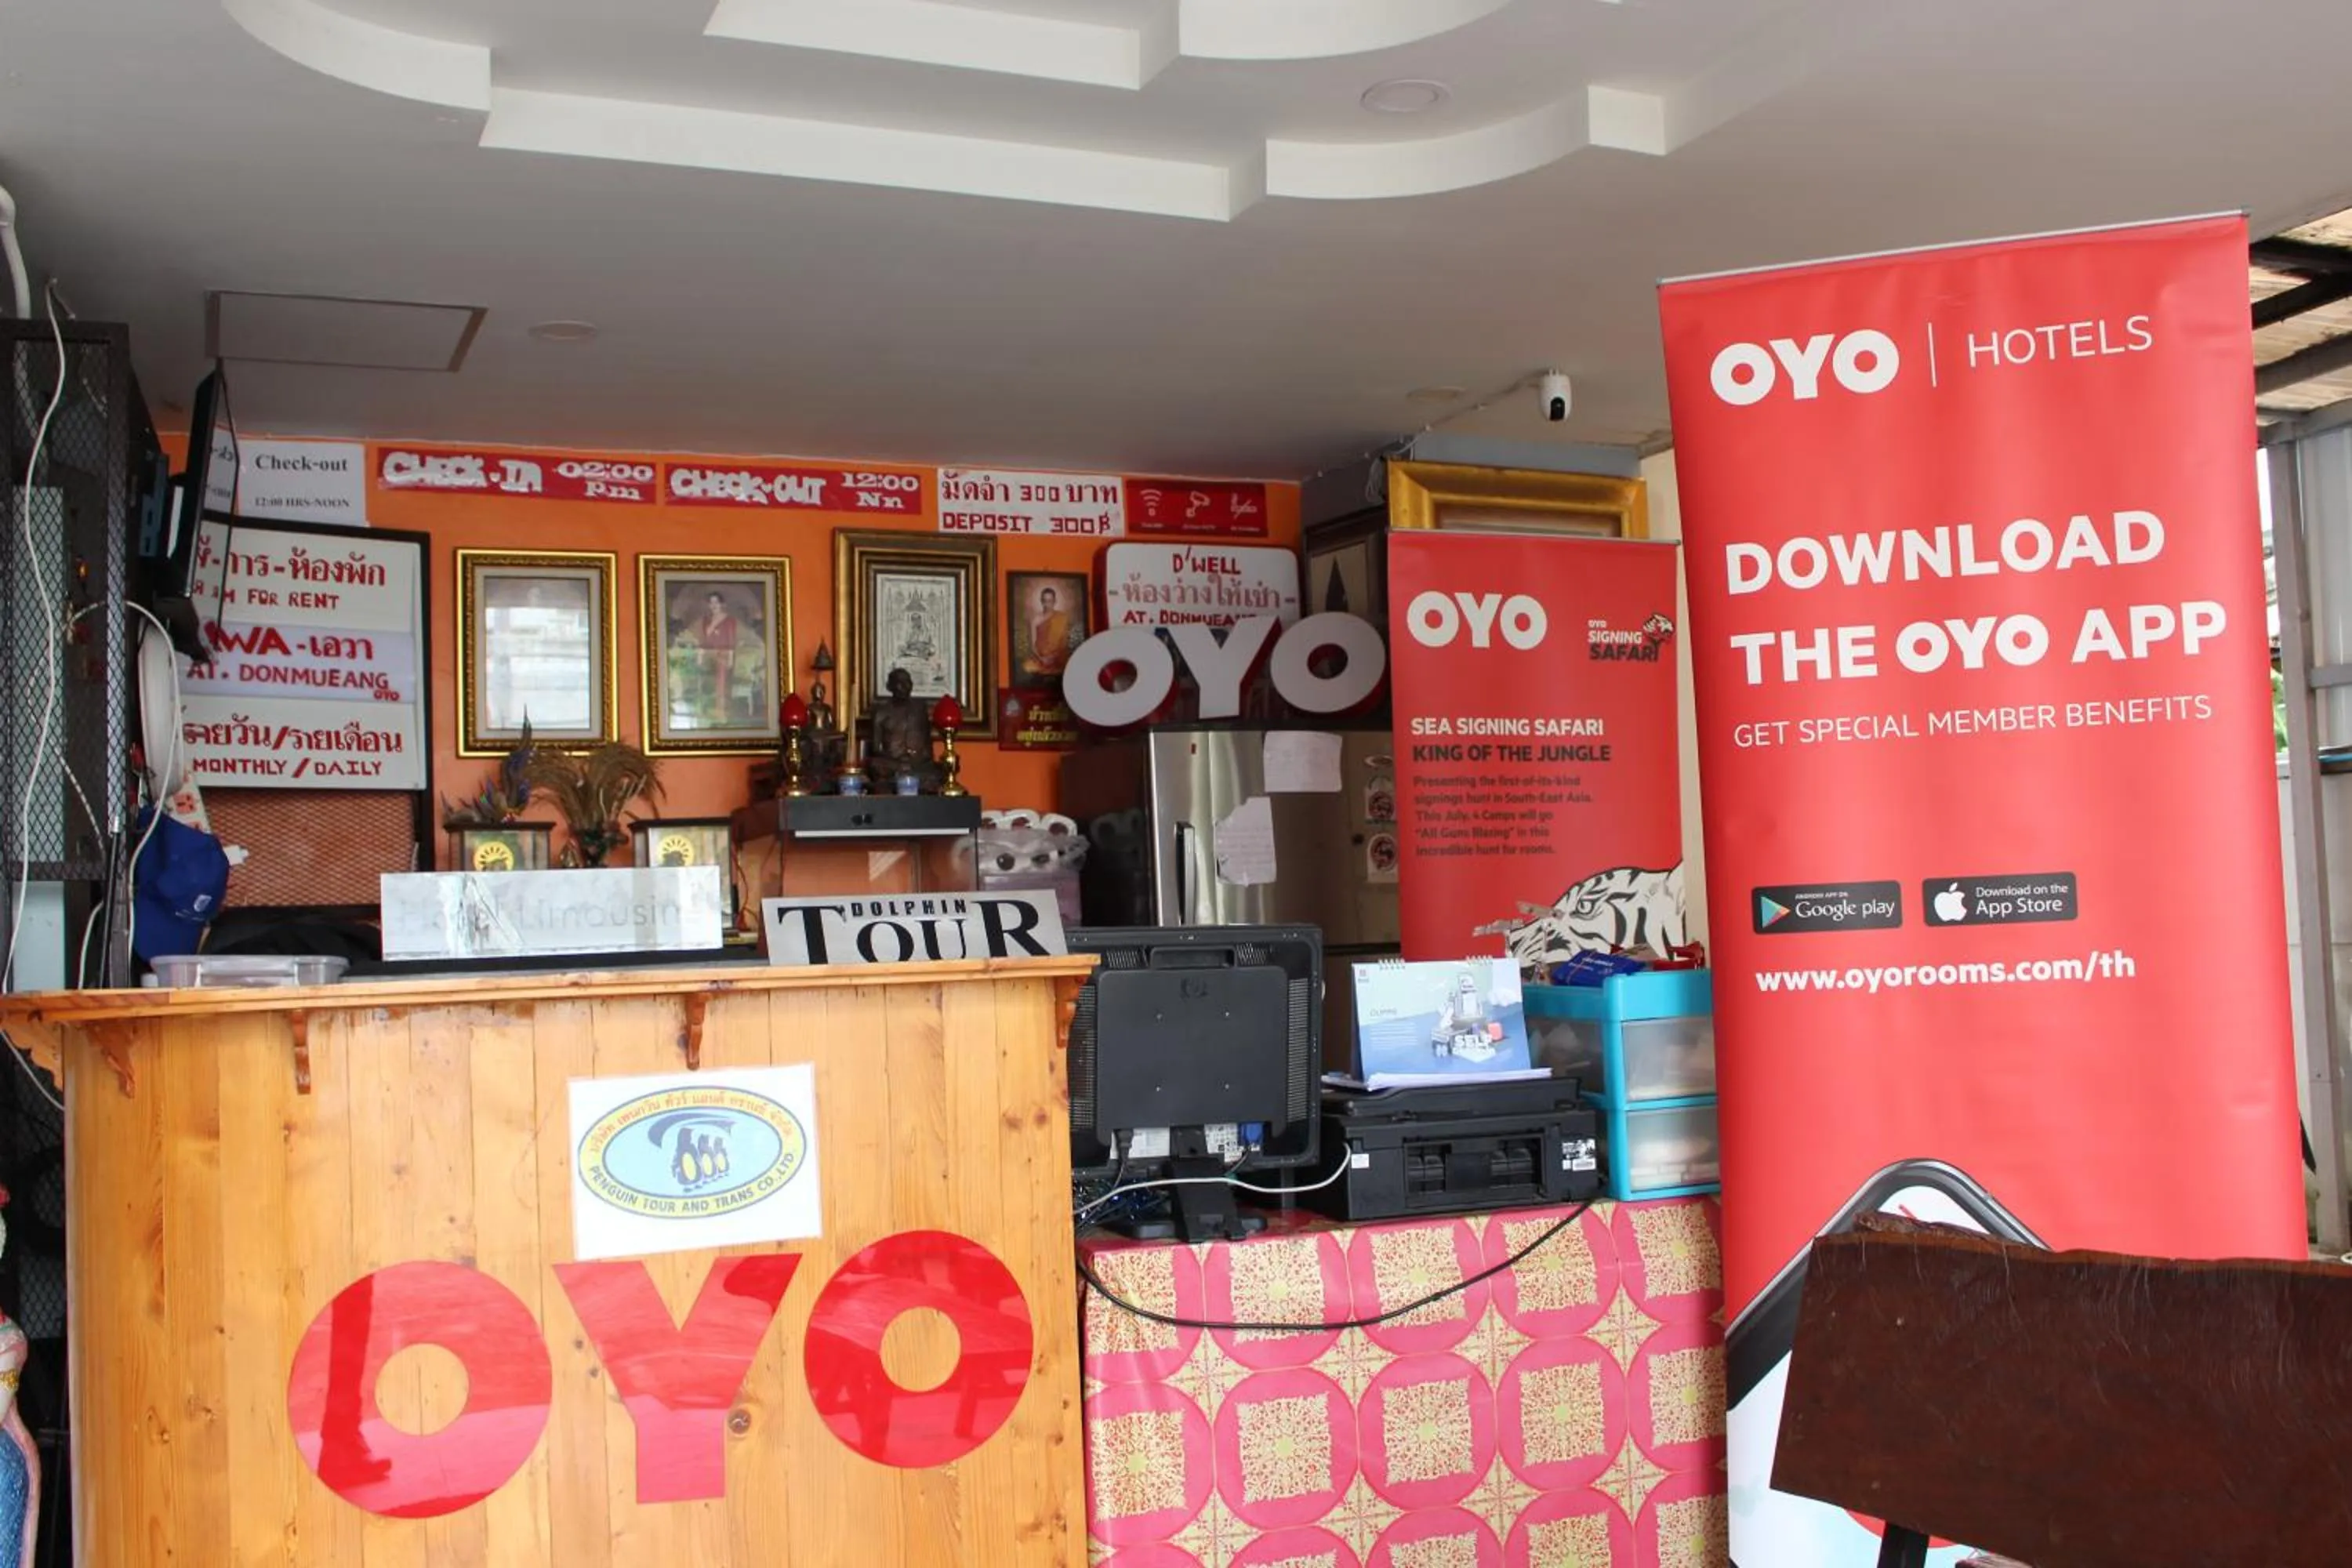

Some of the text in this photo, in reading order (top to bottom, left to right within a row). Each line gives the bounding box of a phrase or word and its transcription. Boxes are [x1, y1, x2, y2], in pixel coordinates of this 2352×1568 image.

[1710, 315, 2153, 405] OYO HOTELS
[255, 454, 347, 470] Check-out
[942, 470, 1117, 503] มัดจำ 300 บาท
[942, 512, 1033, 532] DEPOSIT
[1173, 546, 1241, 574] D'WELL
[1725, 510, 2165, 595] DOWNLOAD
[248, 589, 278, 606] FOR
[289, 593, 339, 609] RENT
[1160, 609, 1258, 626] DONMUEA
[1406, 591, 1547, 650] OYO
[1588, 630, 1642, 644] SIGNING
[1730, 601, 2227, 685] THE OYO APP
[1590, 644, 1659, 662] SAFARI
[239, 664, 389, 690] DONMUEANG
[1062, 611, 1386, 727] OYO
[1412, 717, 1603, 735] SEA SIGNING SAFARI
[1733, 695, 2212, 748] GET SPECIAL MEMBER BENEFITS
[1414, 745, 1611, 761] KING OF THE JUNGLE
[1976, 884, 2068, 898] Download on the
[850, 898, 967, 918] DOLPHIN
[1795, 898, 1895, 922] Google play
[1976, 897, 2063, 918] App Store
[777, 898, 1051, 966] TOUR
[1756, 949, 2136, 994] www.oyorooms.com/th
[589, 1165, 638, 1205] PENGUIN
[643, 1199, 675, 1212] TOUR
[682, 1198, 709, 1210] AND
[715, 1189, 754, 1207] TRANS
[287, 1229, 1034, 1519] OYO
